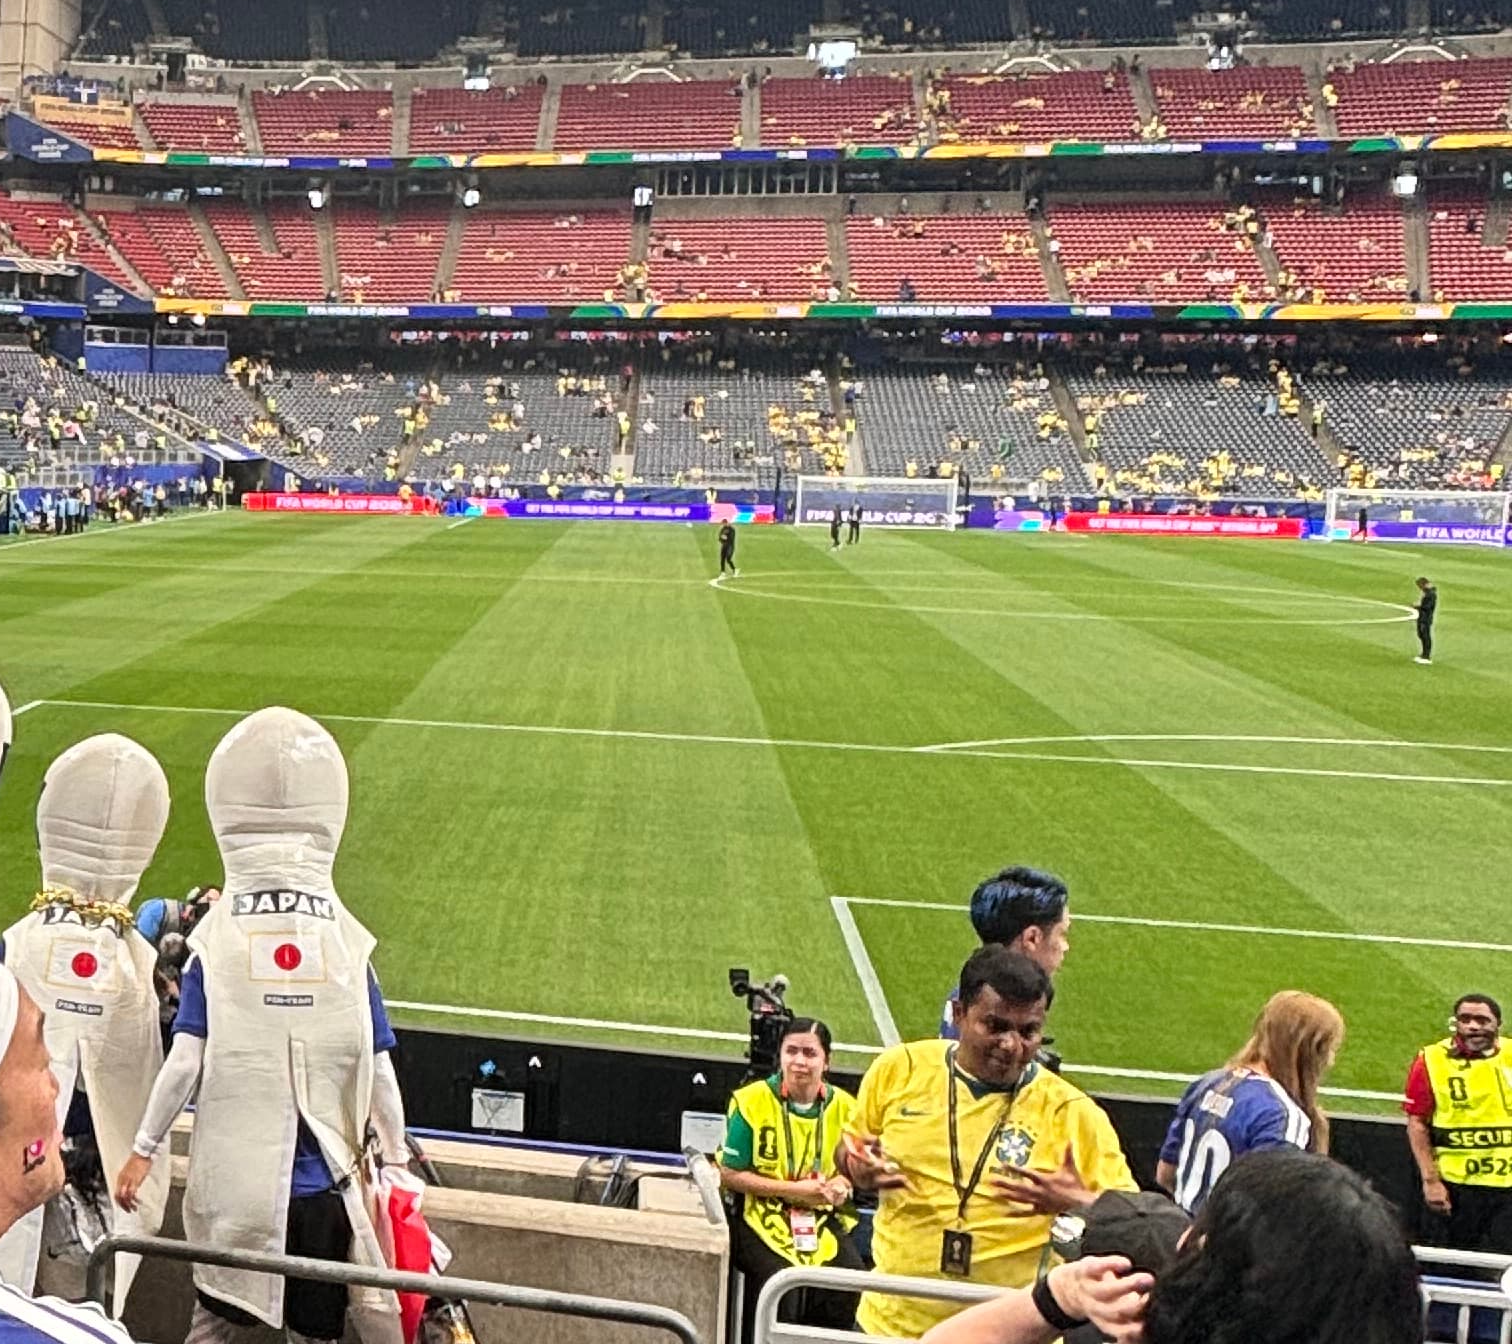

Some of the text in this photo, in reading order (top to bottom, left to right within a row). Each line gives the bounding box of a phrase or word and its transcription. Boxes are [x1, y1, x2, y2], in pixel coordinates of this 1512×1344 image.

[276, 497, 300, 508] FIFA
[301, 498, 343, 509] WORLD
[344, 498, 368, 510] CUP
[806, 510, 835, 521] FIFA
[1417, 527, 1449, 538] FIFA
[237, 891, 333, 918] JAPAN
[1174, 1118, 1231, 1211] 10
